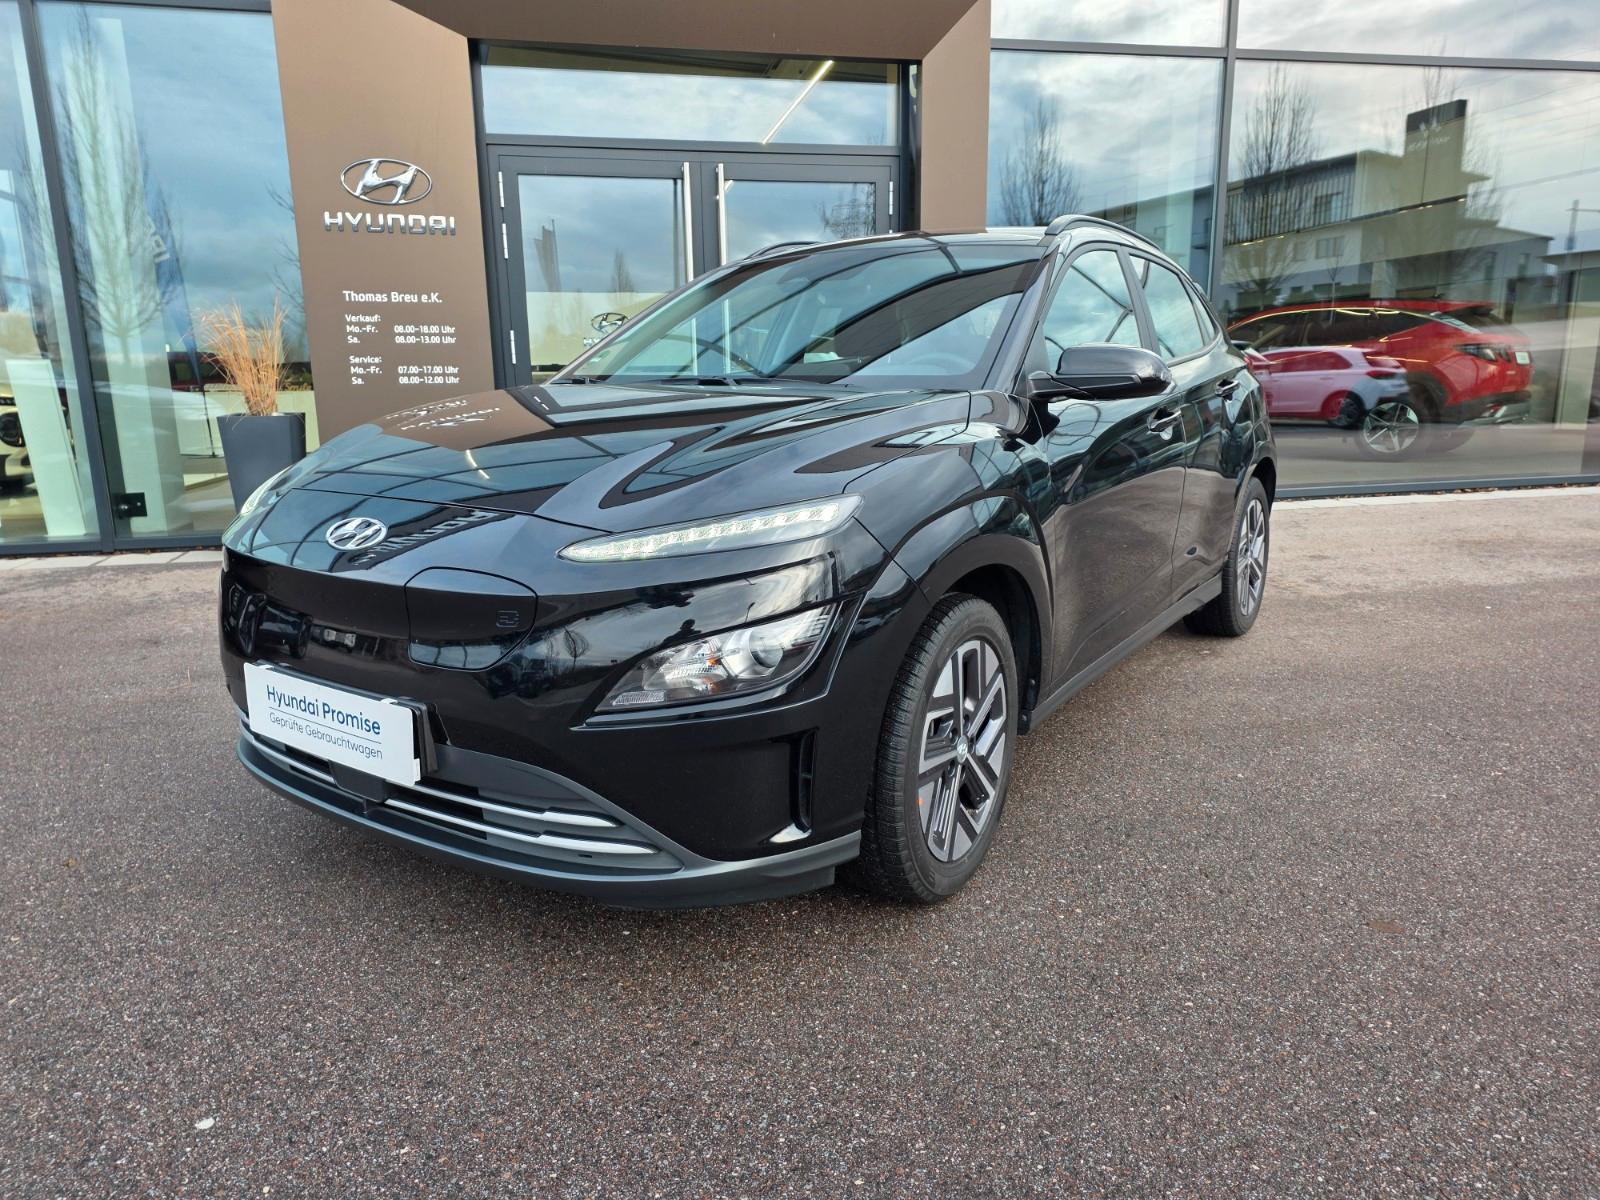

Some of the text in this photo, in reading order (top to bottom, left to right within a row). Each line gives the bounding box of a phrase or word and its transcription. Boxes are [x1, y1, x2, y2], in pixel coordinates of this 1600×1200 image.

[323, 210, 457, 236] HYUNDAI
[342, 290, 443, 303] Thomas Breu e.K.
[345, 313, 381, 323] Verkauf:
[346, 324, 379, 334] Mo.-Fr.
[441, 326, 456, 334] Uhr
[347, 335, 361, 344] Sa.
[442, 336, 457, 344] Uhr
[349, 355, 383, 364] Service:
[350, 366, 383, 375] Mo.-Fr.
[444, 365, 460, 374] Uhr
[351, 376, 365, 385] Sa.
[445, 376, 460, 385] Uhr
[266, 685, 382, 736] Hyundai Promise
[268, 712, 383, 760] Geprüfte Gebrauchtwagen
